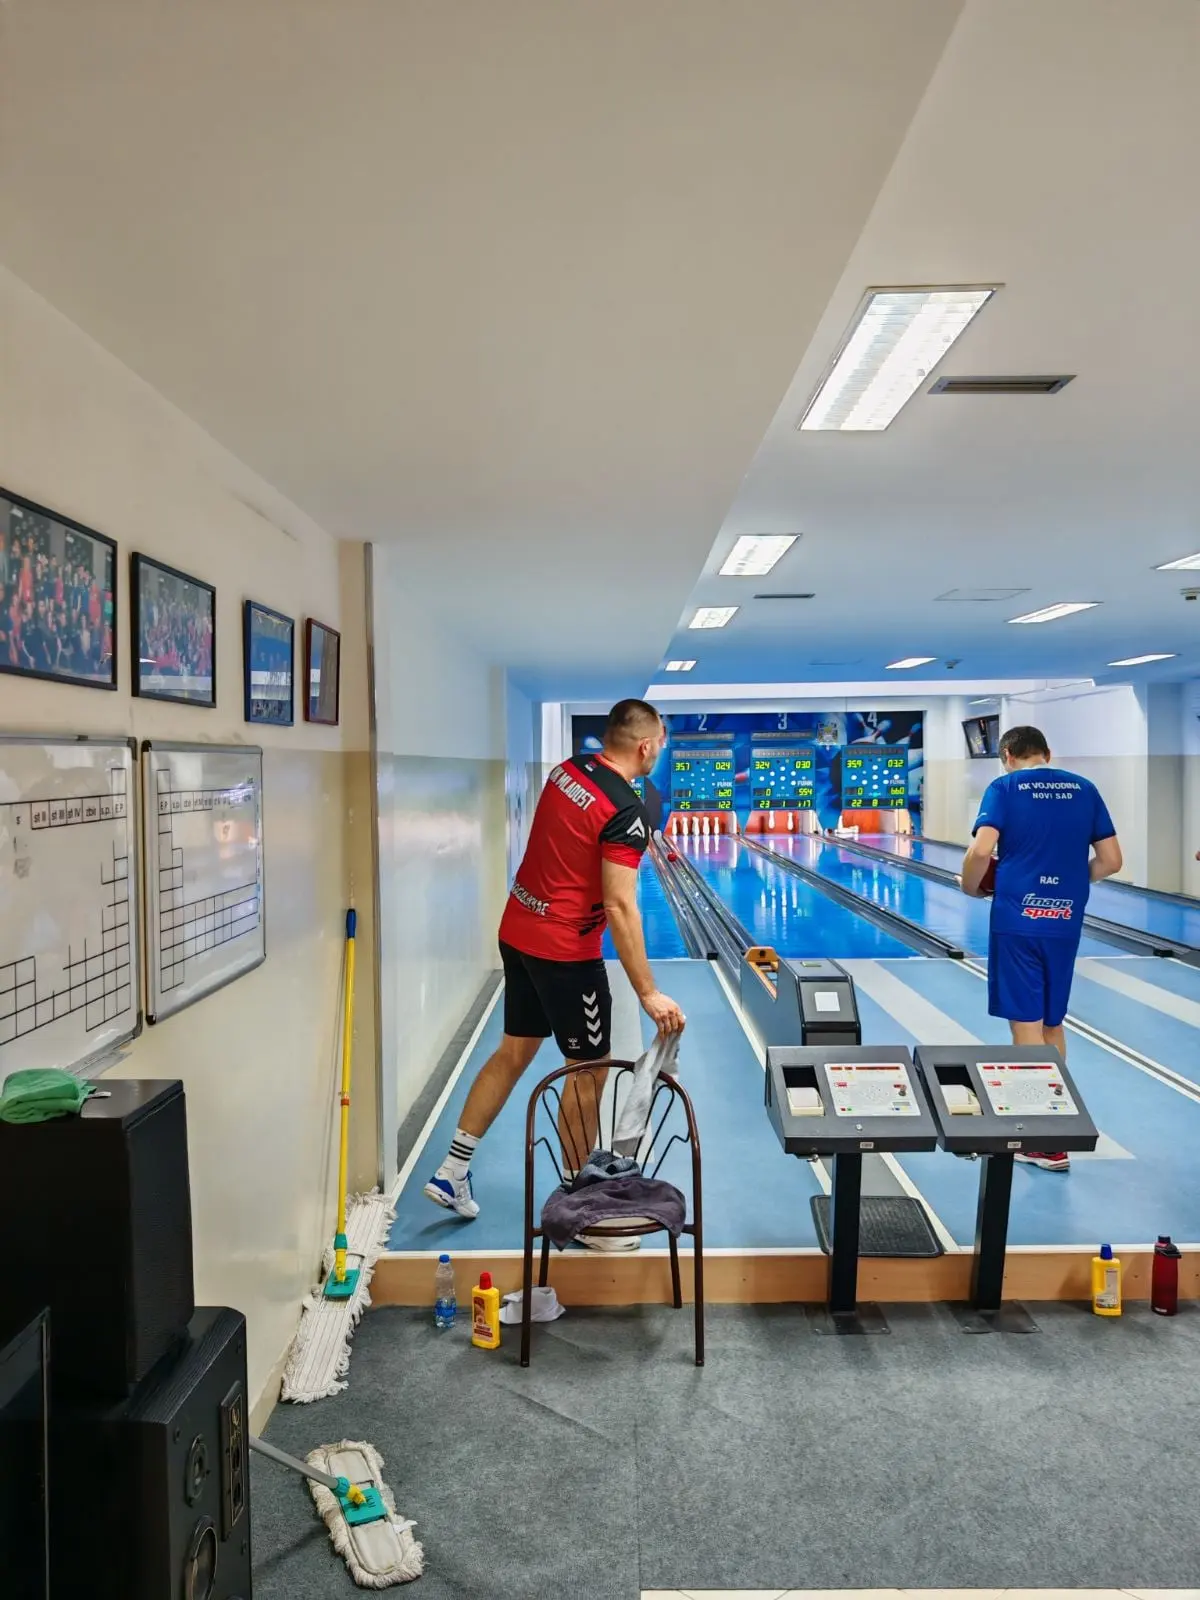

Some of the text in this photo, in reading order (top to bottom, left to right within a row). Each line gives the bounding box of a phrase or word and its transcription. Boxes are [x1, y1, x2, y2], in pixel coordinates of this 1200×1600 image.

[698, 714, 707, 731] 2
[778, 713, 787, 730] 3
[867, 712, 878, 727] 4
[715, 761, 731, 771] 024
[1031, 782, 1081, 790] VOJVODINA
[1040, 876, 1059, 885] RAC
[1022, 893, 1073, 908] image
[1021, 907, 1072, 919] sport
